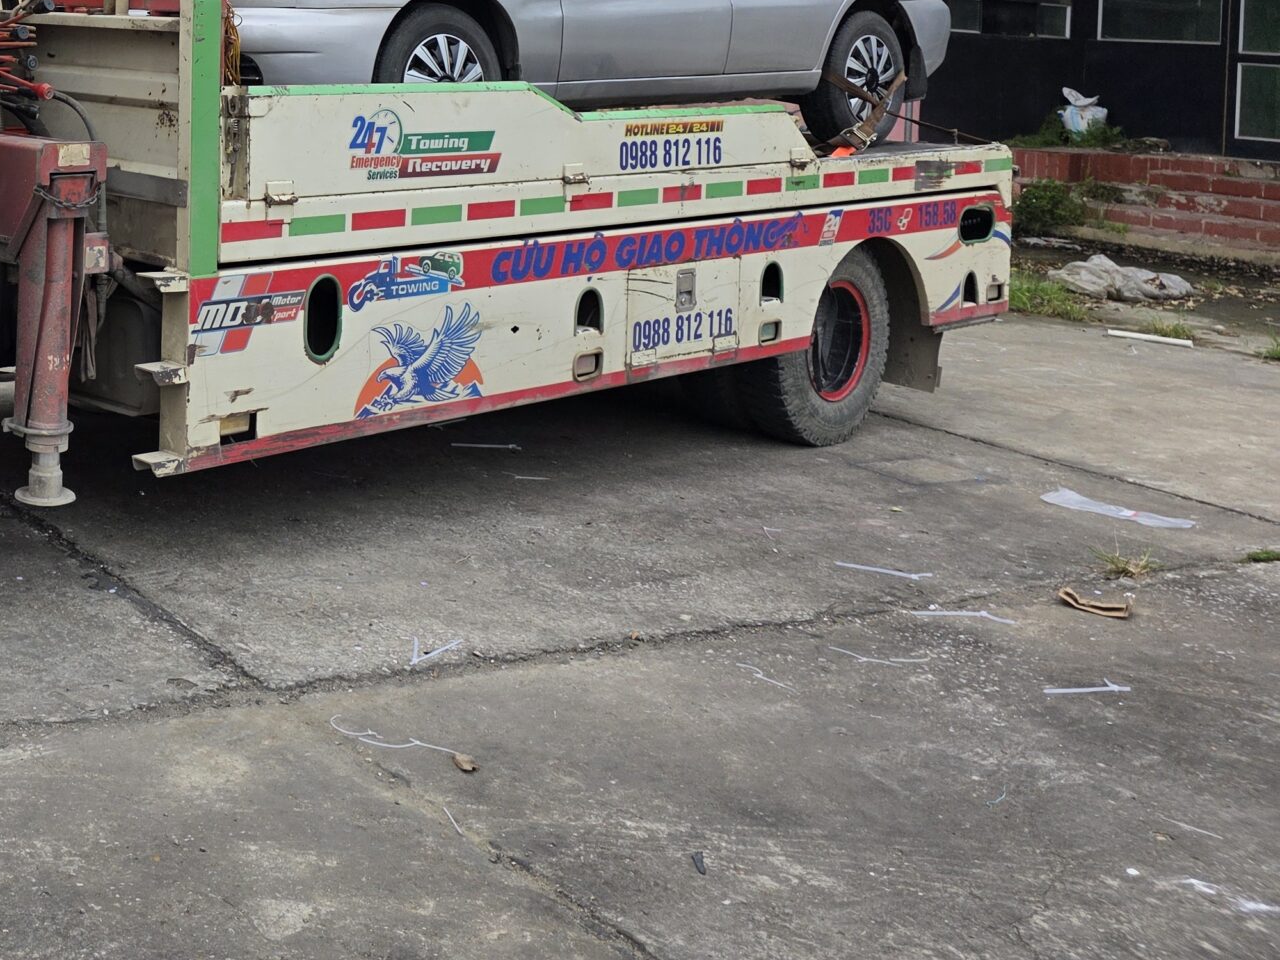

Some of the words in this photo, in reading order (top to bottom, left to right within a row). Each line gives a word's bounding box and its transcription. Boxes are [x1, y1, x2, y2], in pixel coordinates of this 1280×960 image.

[625, 123, 666, 137] HOTLINE
[407, 134, 469, 152] Towing
[620, 139, 658, 171] 0988
[663, 138, 691, 167] 812
[696, 136, 722, 165] 116
[350, 155, 402, 170] Emergency
[407, 158, 492, 173] Recovery
[367, 169, 398, 180] Services
[868, 207, 893, 234] 35C
[918, 200, 957, 228] 158.58
[490, 239, 556, 284] CỨU
[560, 231, 608, 283] HỘ
[614, 229, 687, 270] GIAO
[692, 217, 779, 258] THÔNG
[391, 281, 440, 295] TOWING
[272, 295, 303, 306] Motor
[632, 317, 670, 351] 0988
[675, 312, 703, 343] 812
[708, 307, 733, 337] 116
